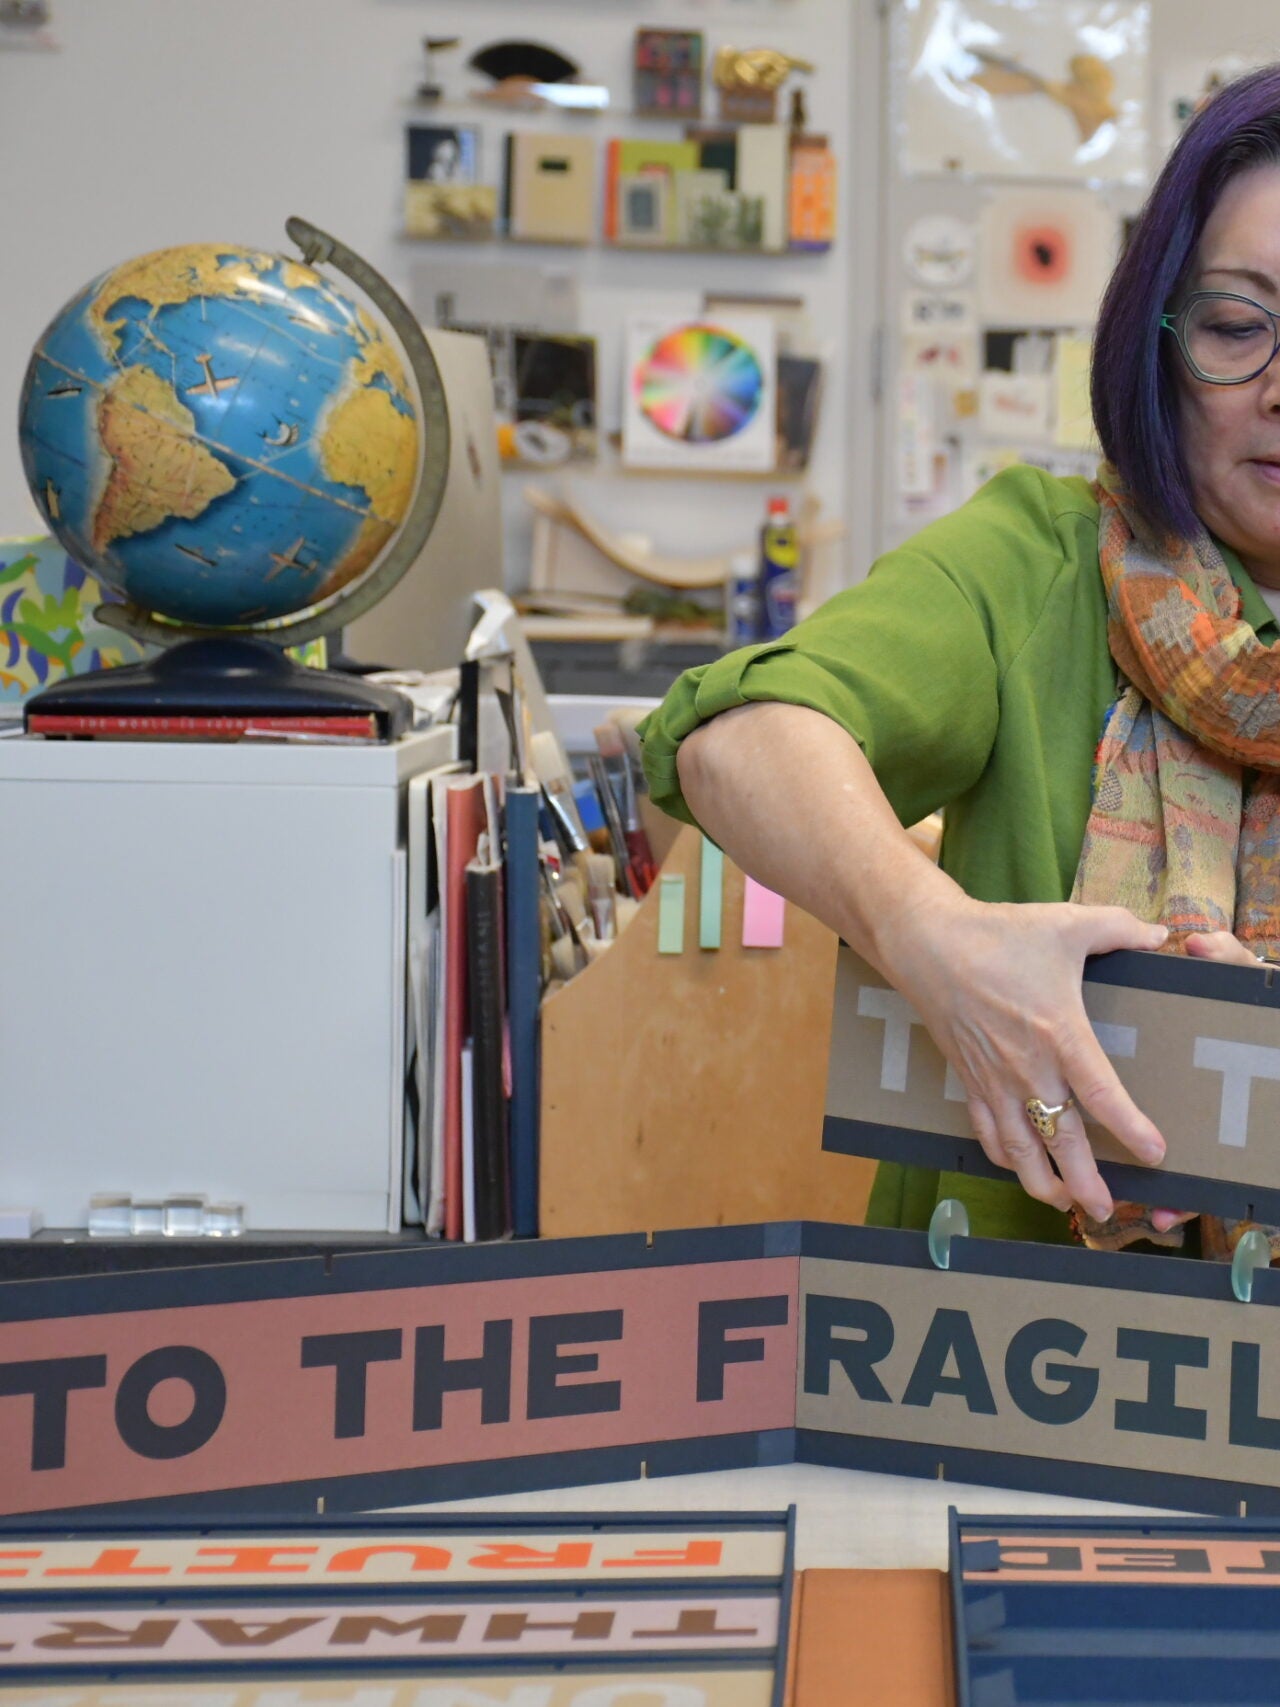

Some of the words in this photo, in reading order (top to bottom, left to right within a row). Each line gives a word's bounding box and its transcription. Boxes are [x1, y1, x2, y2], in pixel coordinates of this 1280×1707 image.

[0, 1345, 226, 1470] TO
[301, 1309, 623, 1439] THE
[0, 1609, 758, 1652] THWAR
